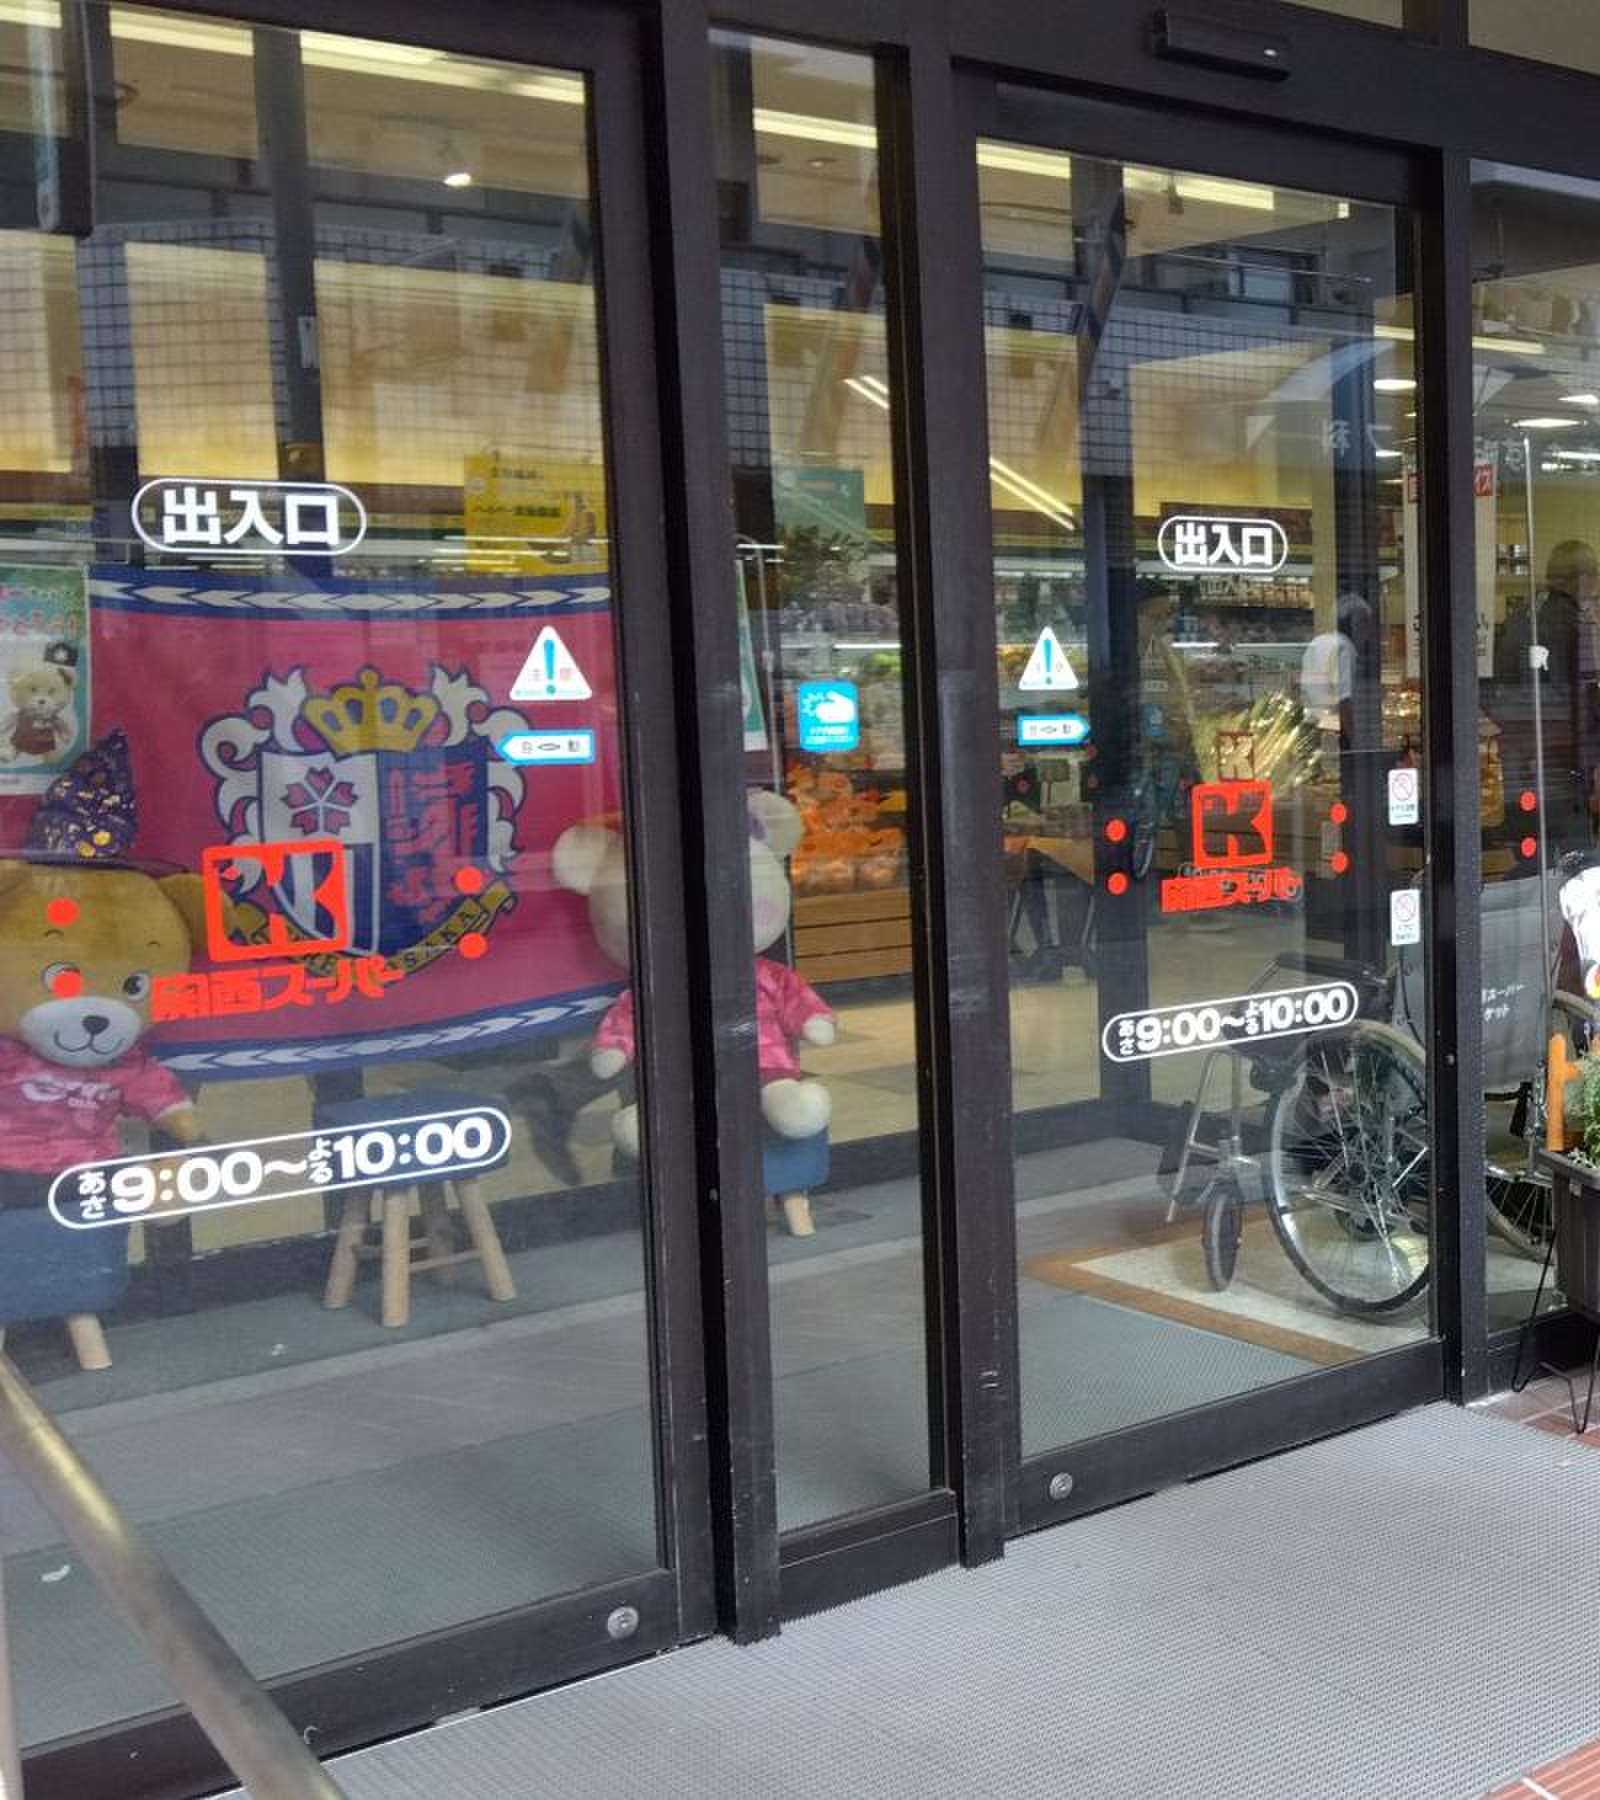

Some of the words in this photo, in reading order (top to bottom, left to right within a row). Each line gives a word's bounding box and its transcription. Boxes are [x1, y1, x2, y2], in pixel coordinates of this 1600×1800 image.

[163, 487, 341, 545] 出入口
[1174, 522, 1273, 566] 出入口
